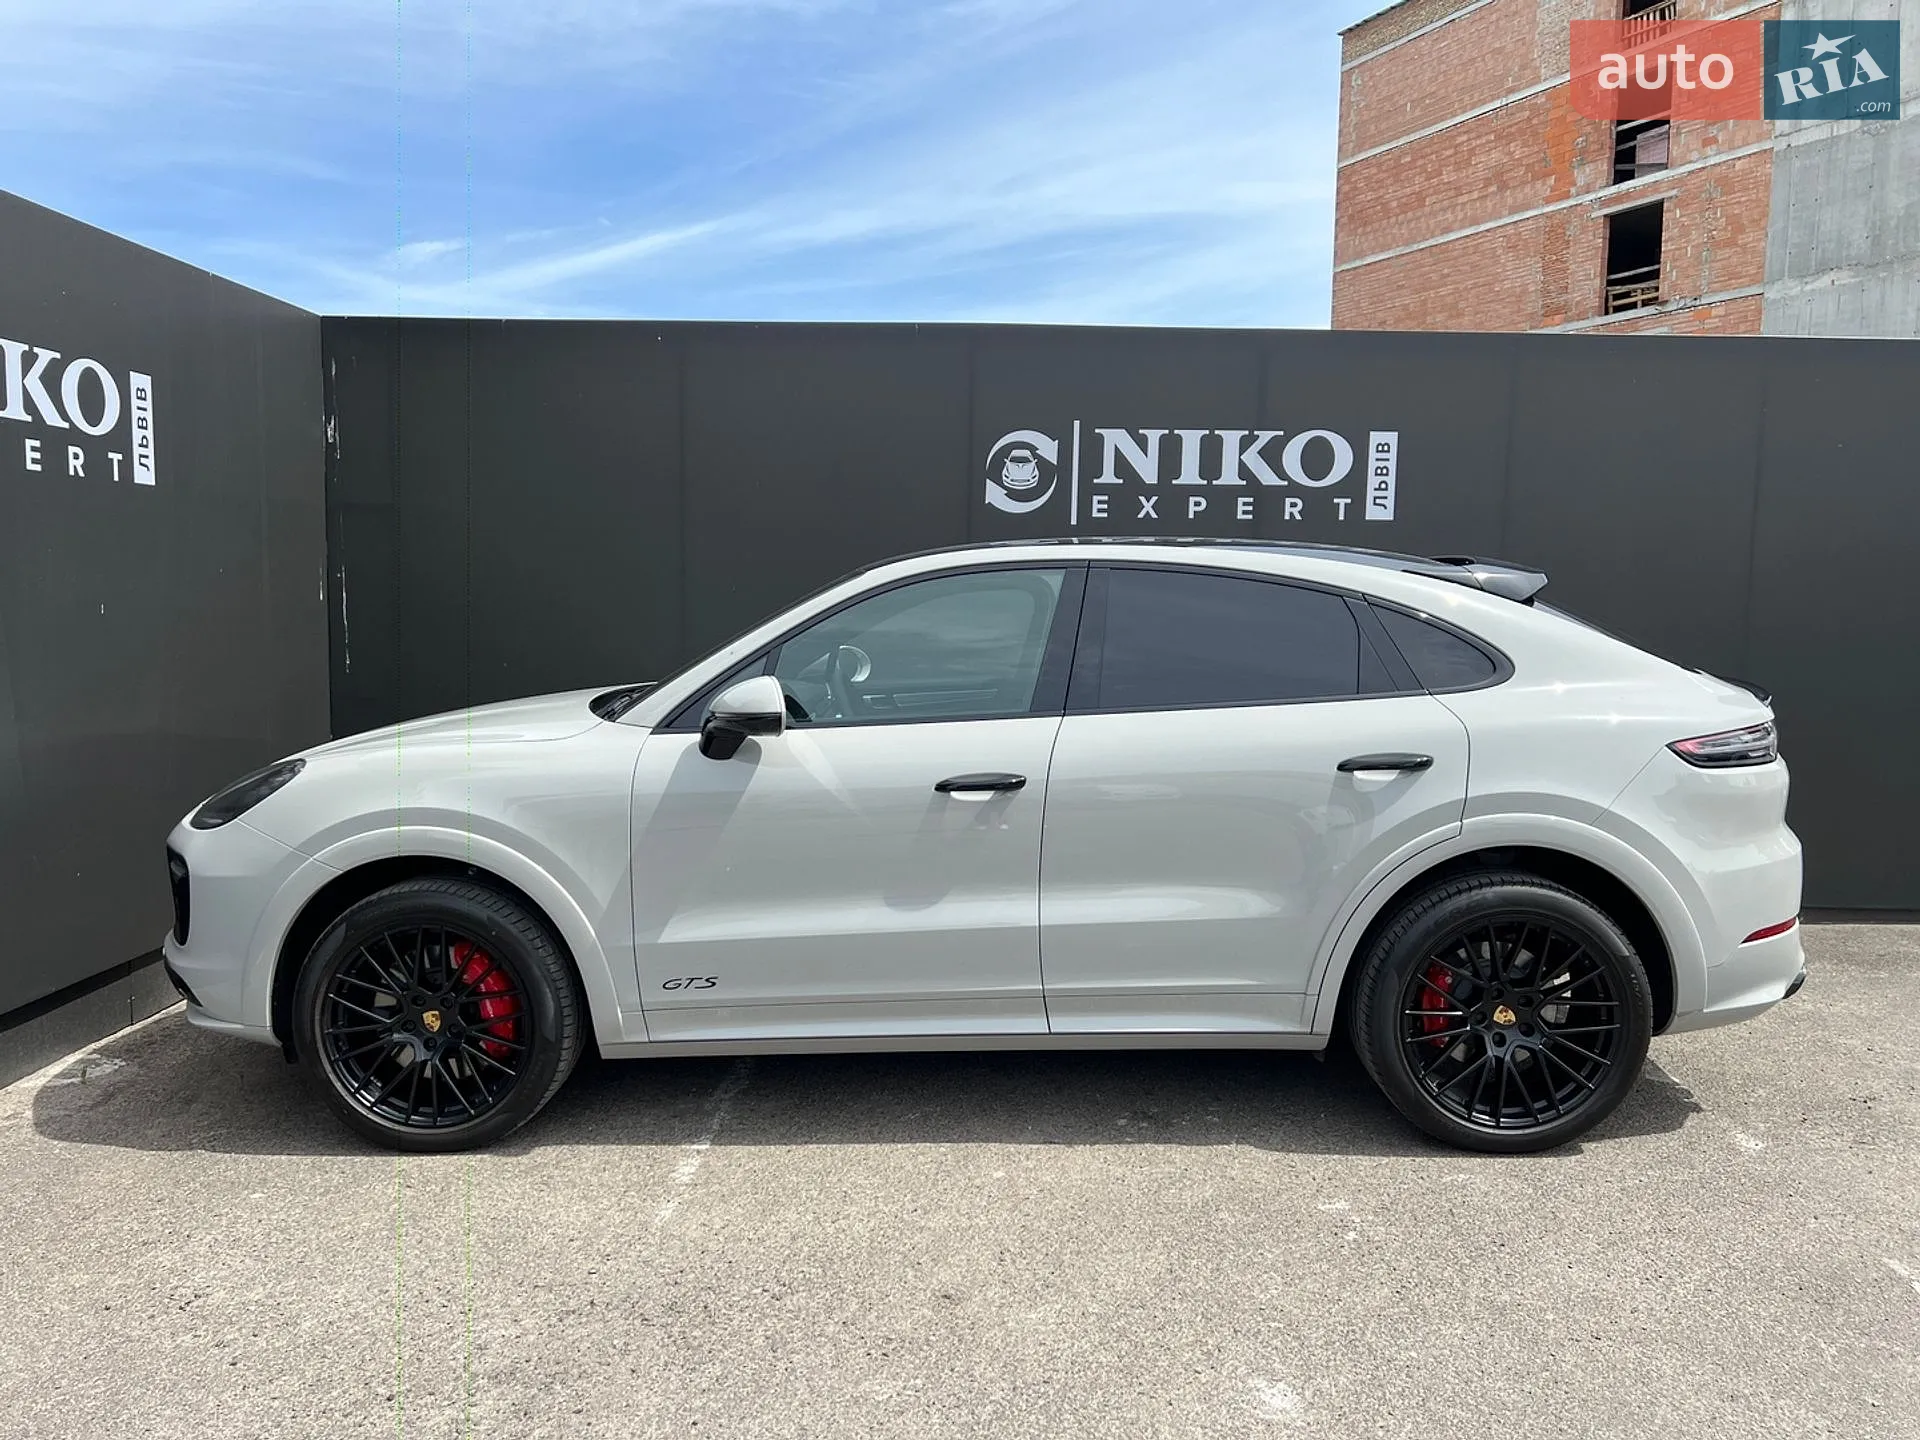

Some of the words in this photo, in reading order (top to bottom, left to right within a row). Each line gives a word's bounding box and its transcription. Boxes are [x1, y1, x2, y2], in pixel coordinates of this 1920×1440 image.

[1093, 428, 1354, 488] NIKO
[1091, 495, 1352, 521] EXPERT
[662, 976, 719, 990] GTS
